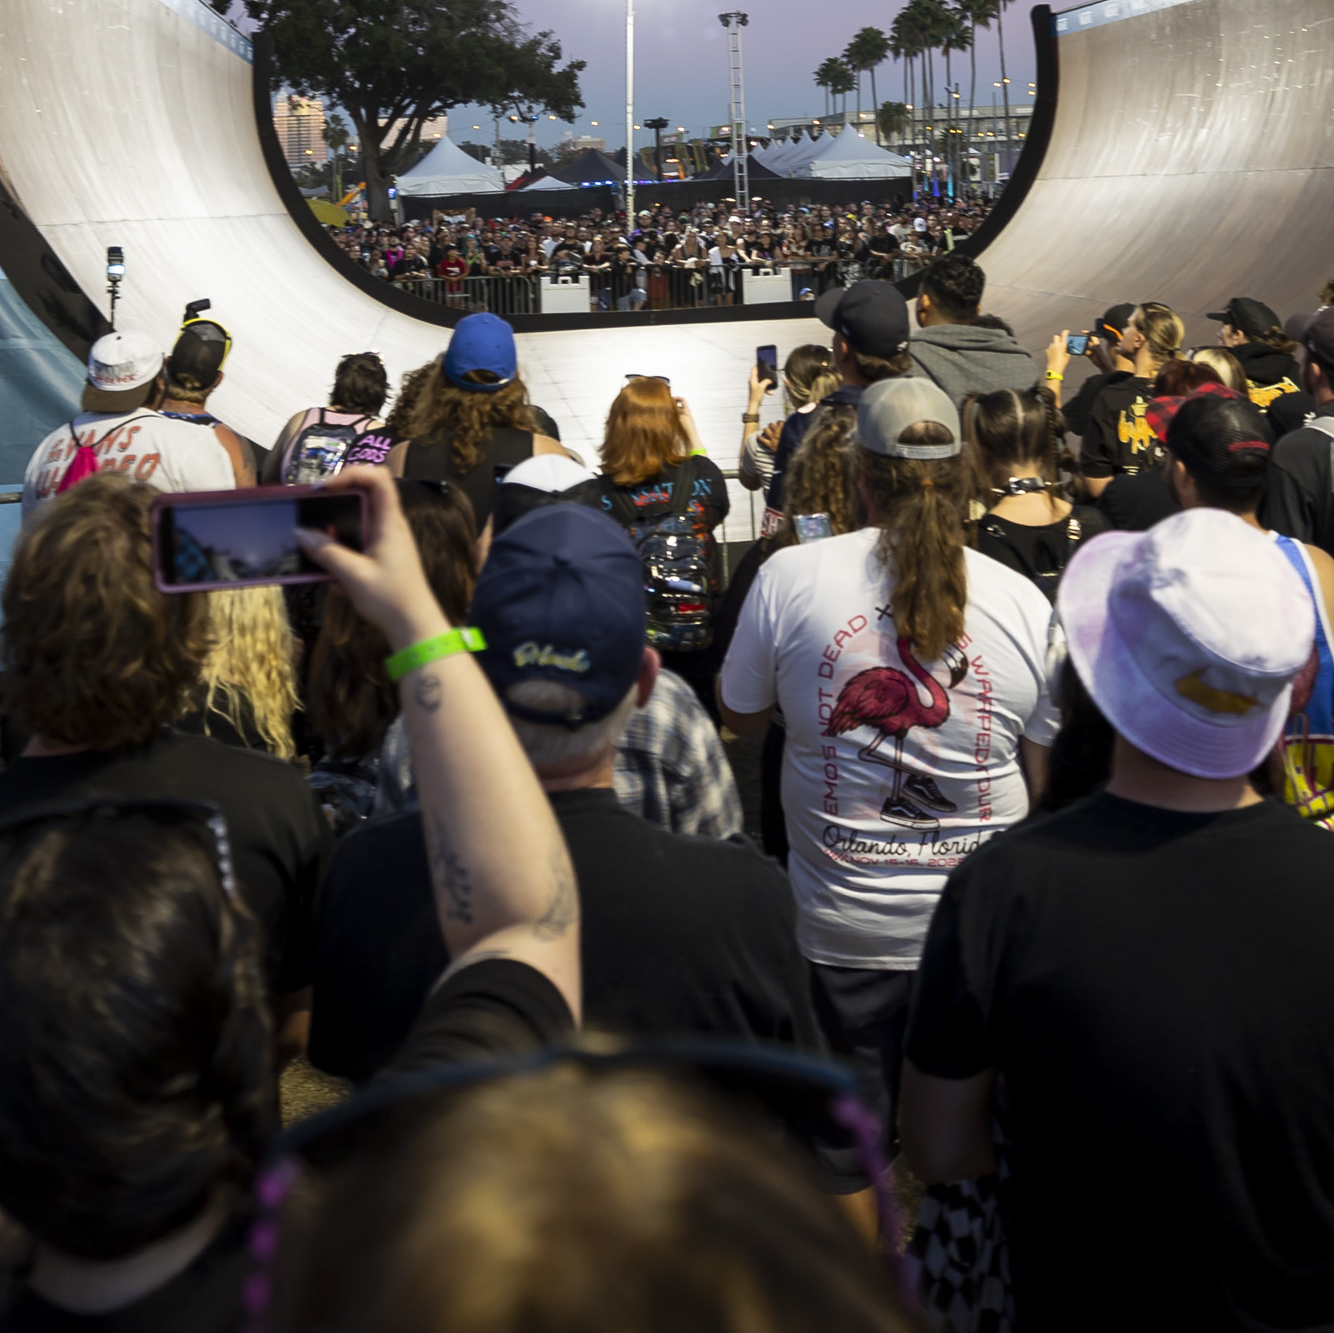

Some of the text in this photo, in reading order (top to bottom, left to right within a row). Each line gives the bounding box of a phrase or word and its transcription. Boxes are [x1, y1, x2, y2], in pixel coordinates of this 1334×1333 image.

[356, 434, 393, 451] ALL
[818, 614, 869, 681] DEAD
[822, 745, 840, 817] EMOS
[822, 824, 983, 858] Orlando, Florid
